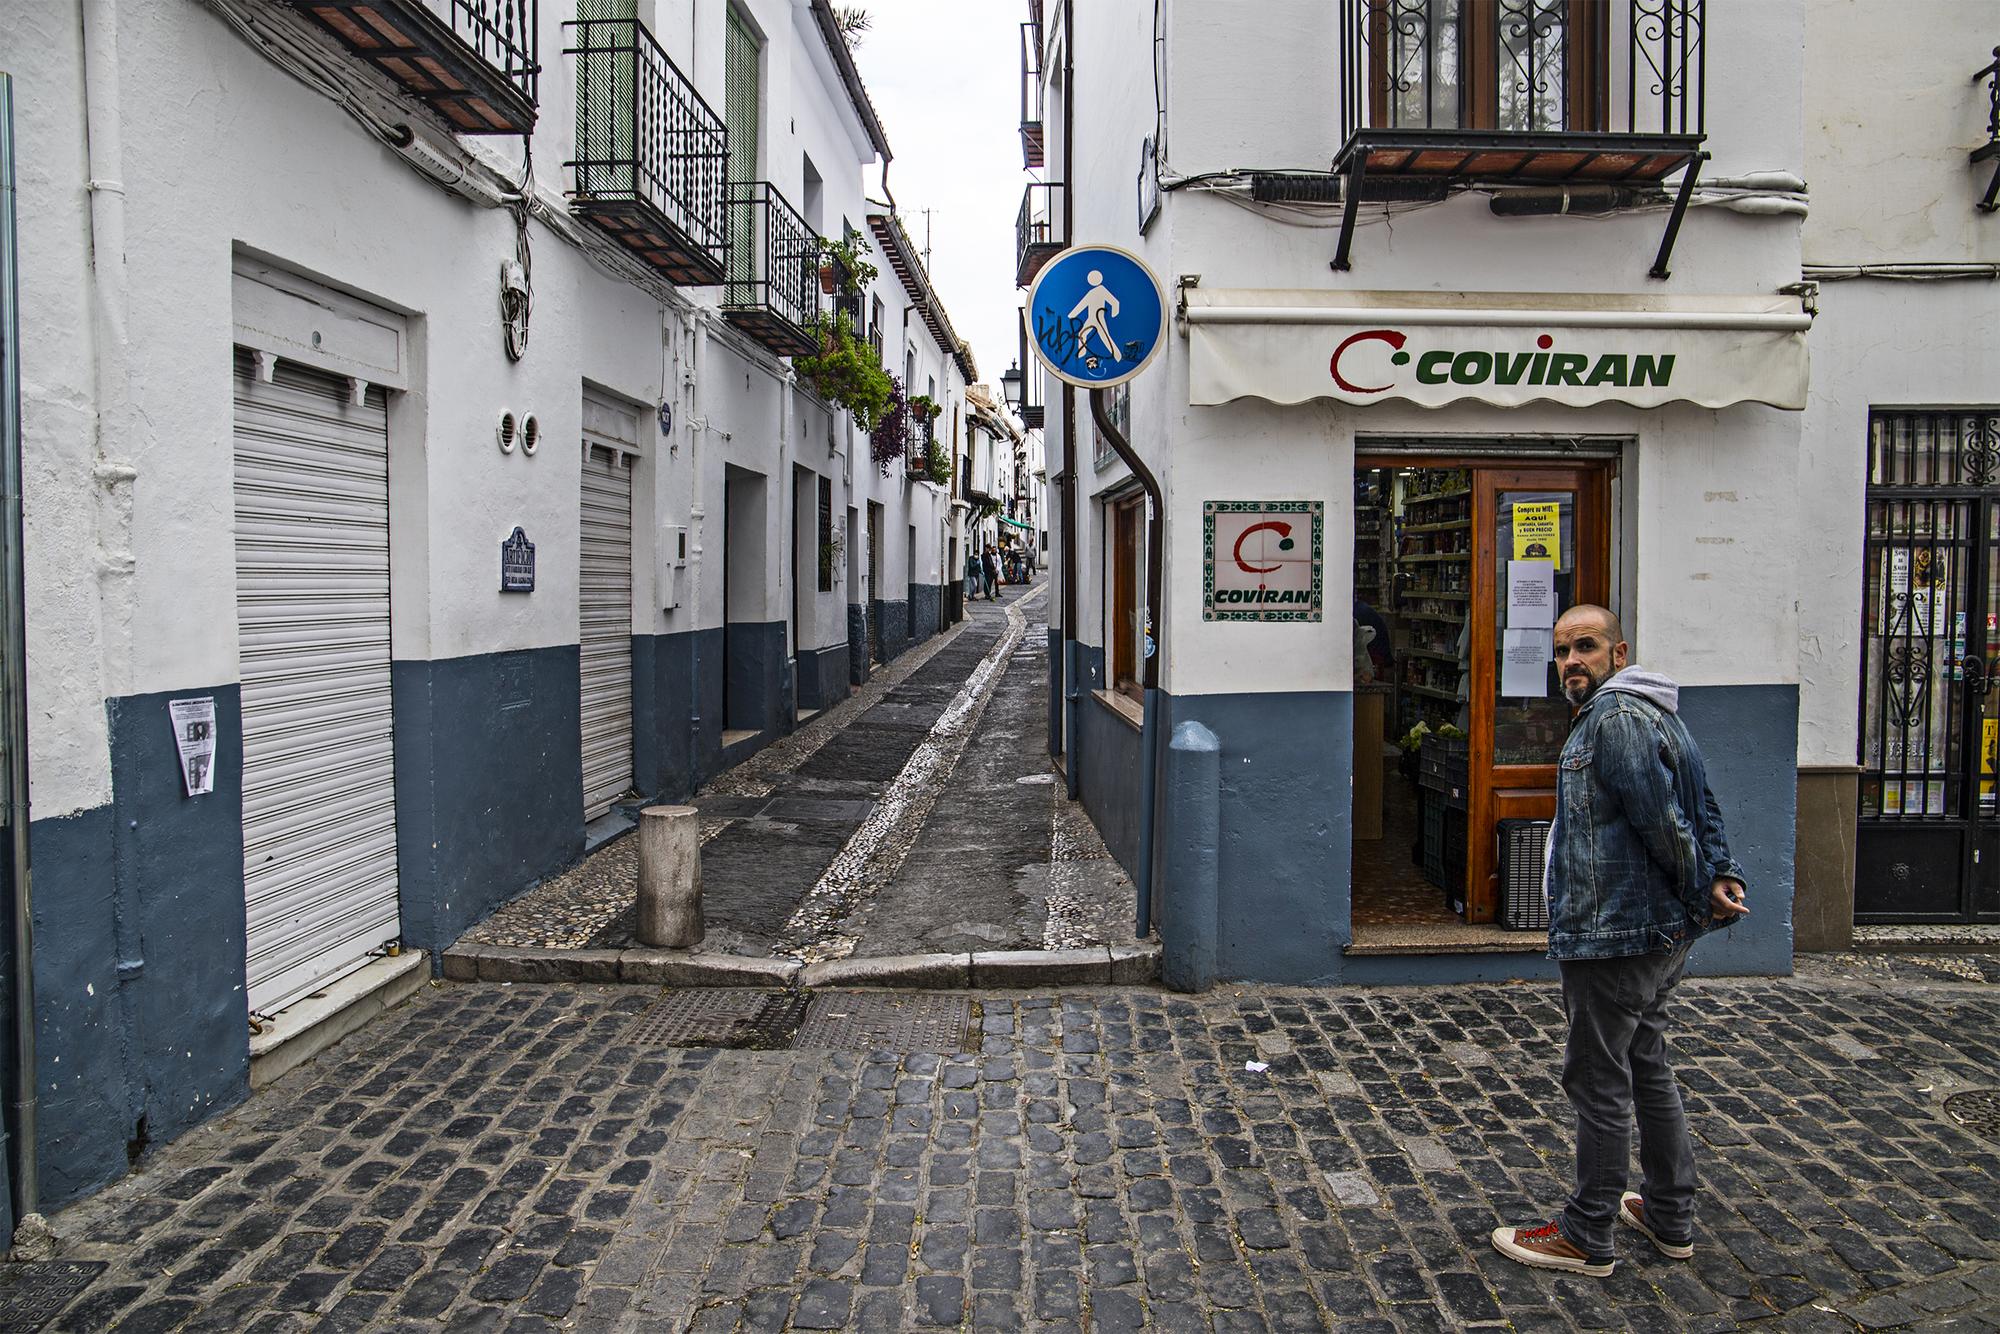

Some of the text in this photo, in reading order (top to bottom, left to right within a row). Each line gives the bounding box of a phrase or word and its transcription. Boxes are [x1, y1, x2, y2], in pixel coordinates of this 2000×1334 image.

[1416, 334, 1676, 387] COVIRAN
[1517, 506, 1534, 514] Compre
[1542, 505, 1554, 513] MIEL
[1215, 583, 1311, 603] COVIRAN
